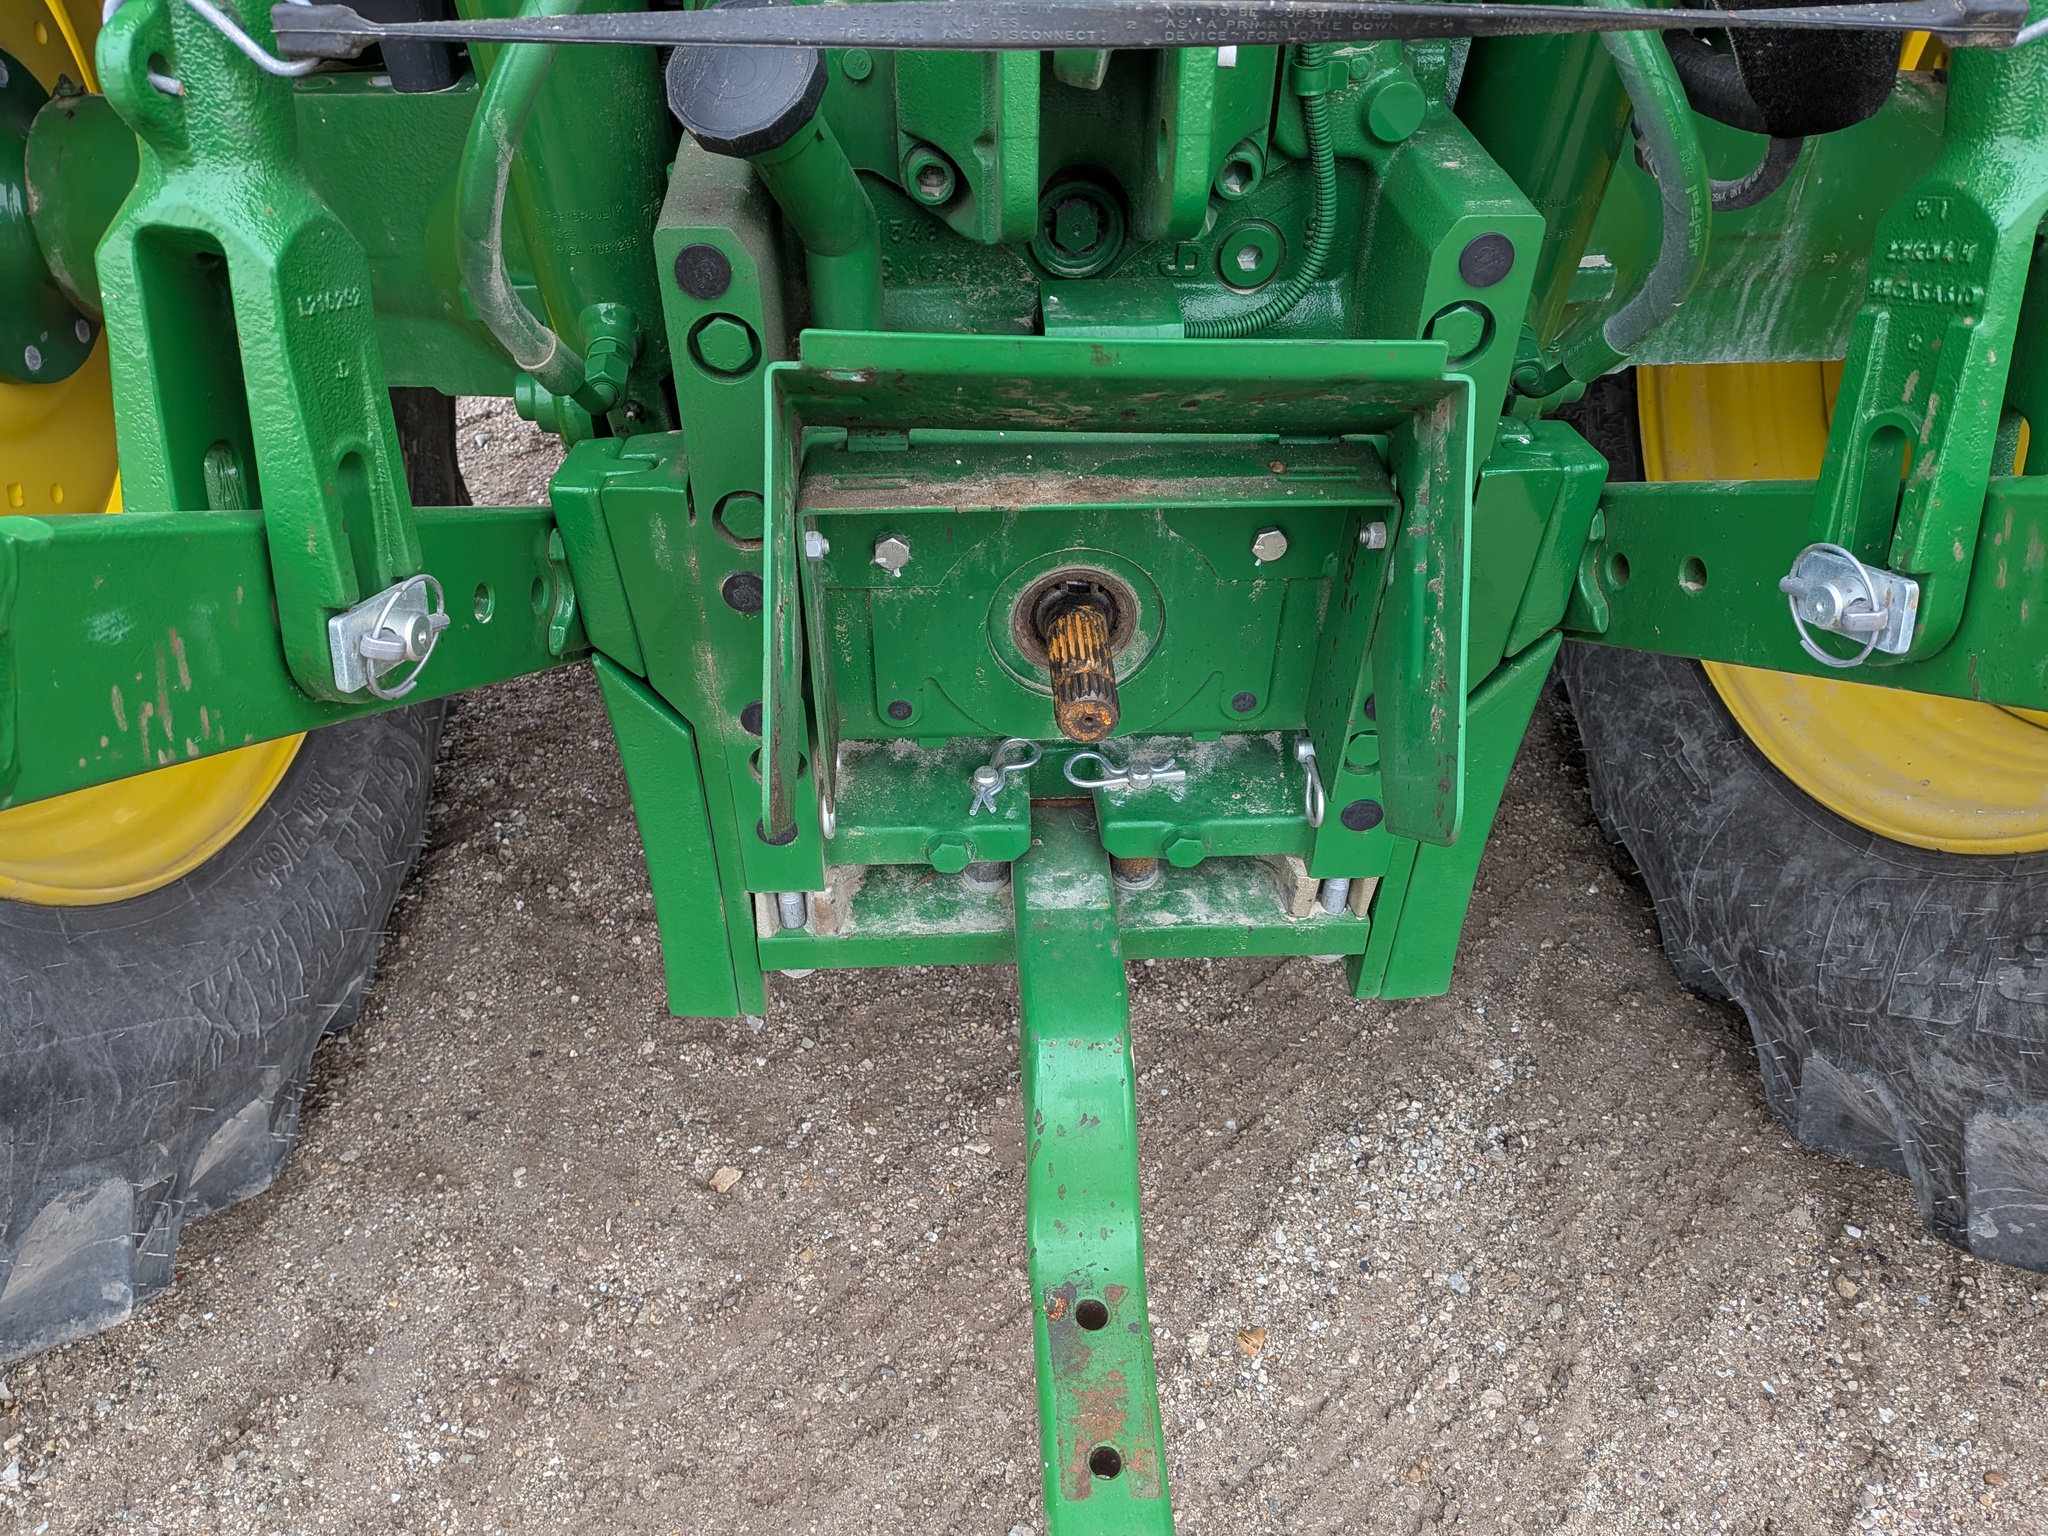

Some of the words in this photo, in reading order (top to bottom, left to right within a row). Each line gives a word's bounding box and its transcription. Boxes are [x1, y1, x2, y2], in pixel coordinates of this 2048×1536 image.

[1165, 7, 1197, 18] NOT
[1209, 7, 1231, 18] TO
[1273, 9, 1393, 20] SUBSTITUTED
[1126, 20, 1137, 30] 2
[1165, 19, 1188, 29] AS
[1206, 19, 1218, 29] A
[1226, 20, 1302, 31] PRIMARY
[1315, 21, 1342, 31] TIE
[1352, 22, 1400, 32] DOWN
[1165, 31, 1227, 42] DEVICE
[1247, 31, 1278, 41] FOR
